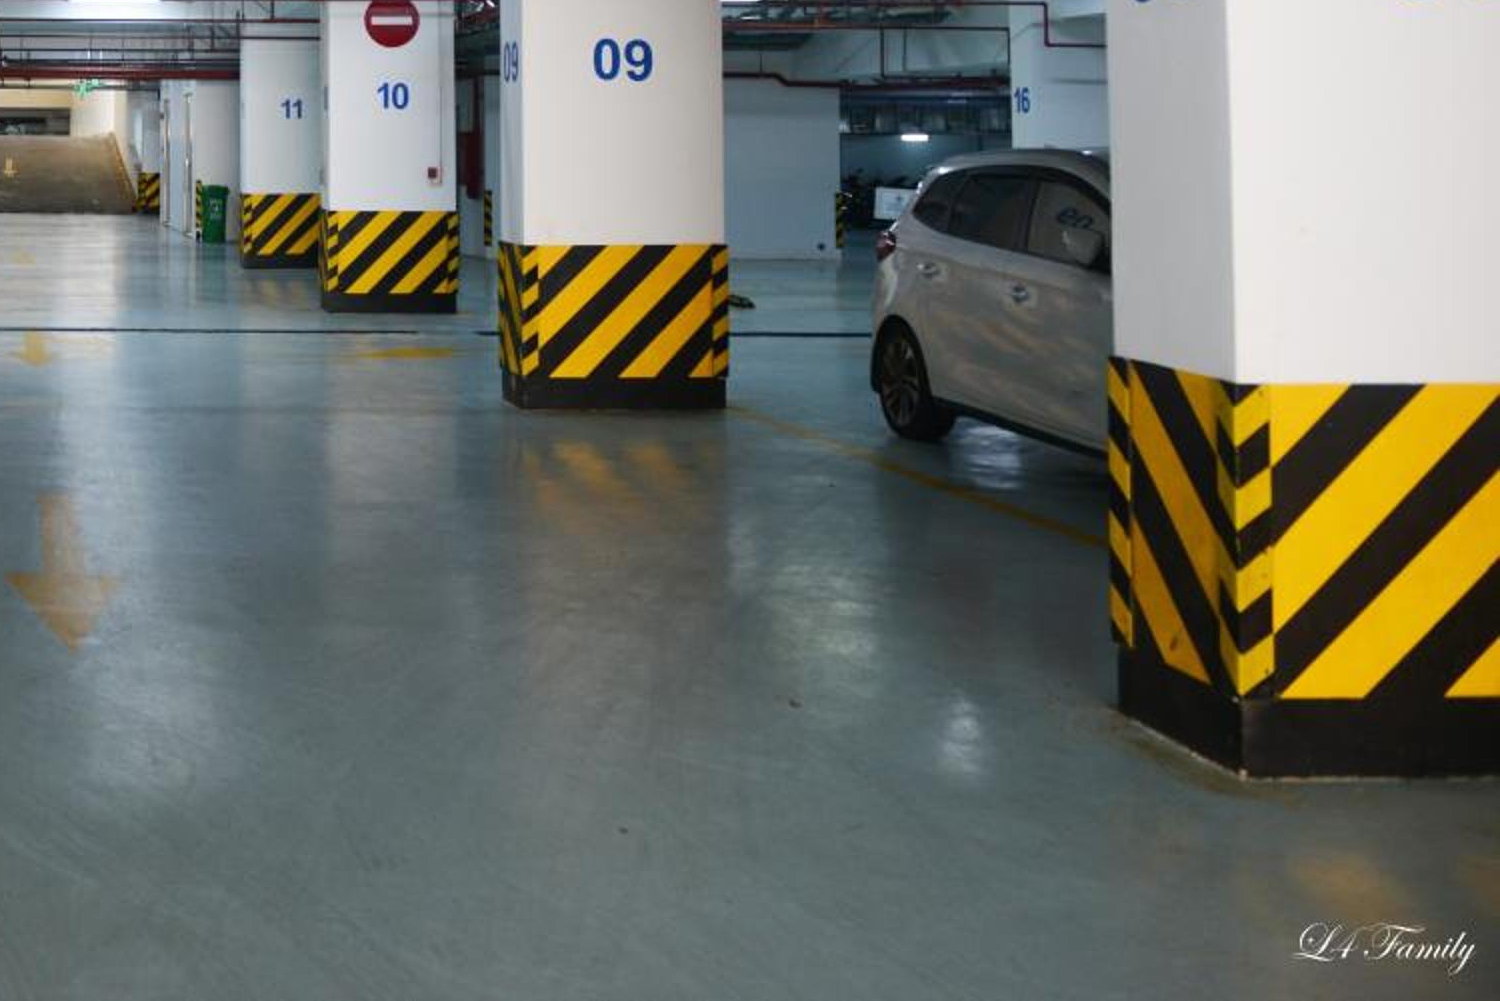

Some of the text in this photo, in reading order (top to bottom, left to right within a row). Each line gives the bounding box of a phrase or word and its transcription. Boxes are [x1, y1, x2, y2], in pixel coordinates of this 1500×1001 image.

[502, 41, 519, 83] 09
[593, 38, 653, 81] 09
[281, 98, 303, 120] 11
[377, 82, 410, 110] 10
[1013, 87, 1031, 114] 16
